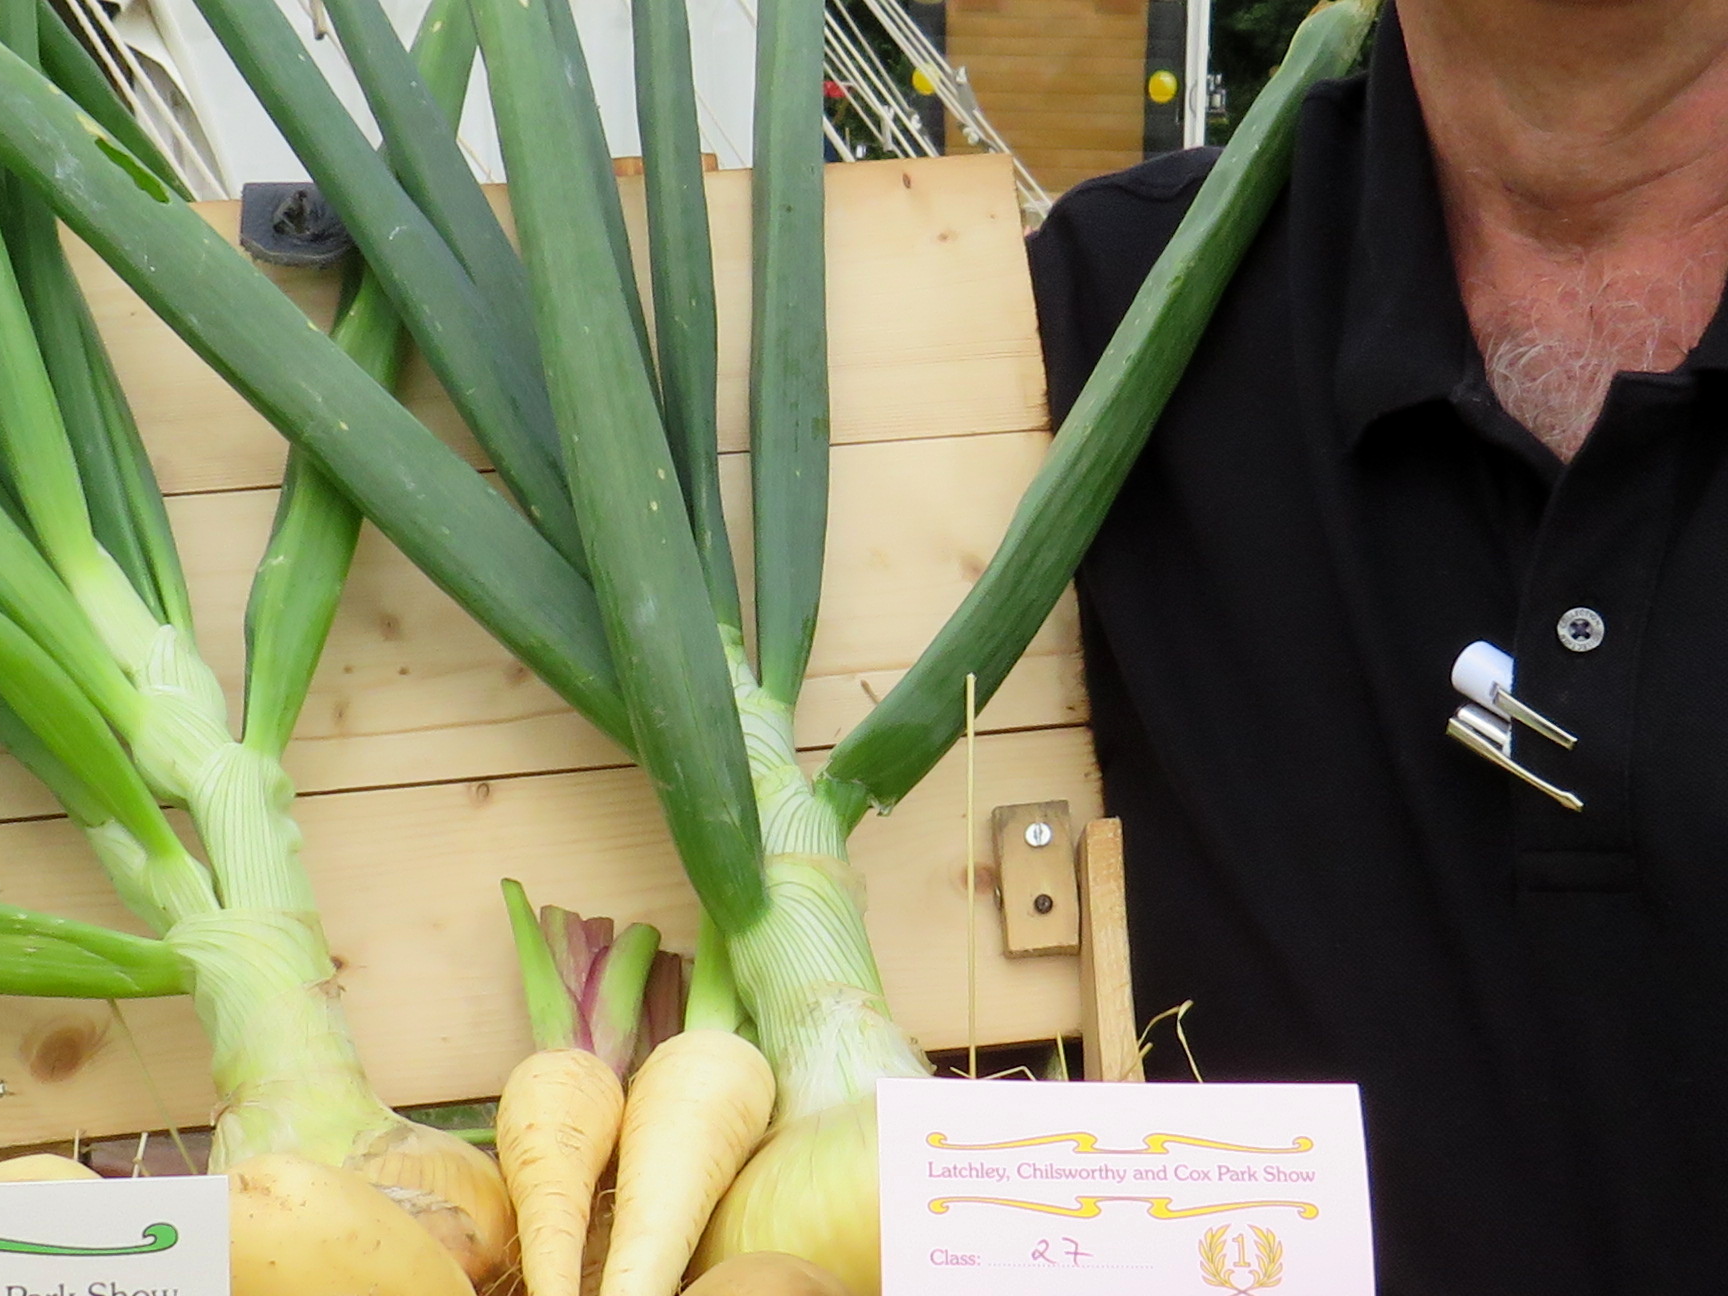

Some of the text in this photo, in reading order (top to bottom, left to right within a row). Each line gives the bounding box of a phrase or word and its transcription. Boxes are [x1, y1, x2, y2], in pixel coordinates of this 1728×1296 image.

[928, 1162, 1315, 1183] Latchley, Chilsworthy and Cox Park Show
[930, 1236, 1092, 1266] Class: 27
[1231, 1233, 1251, 1267] 1
